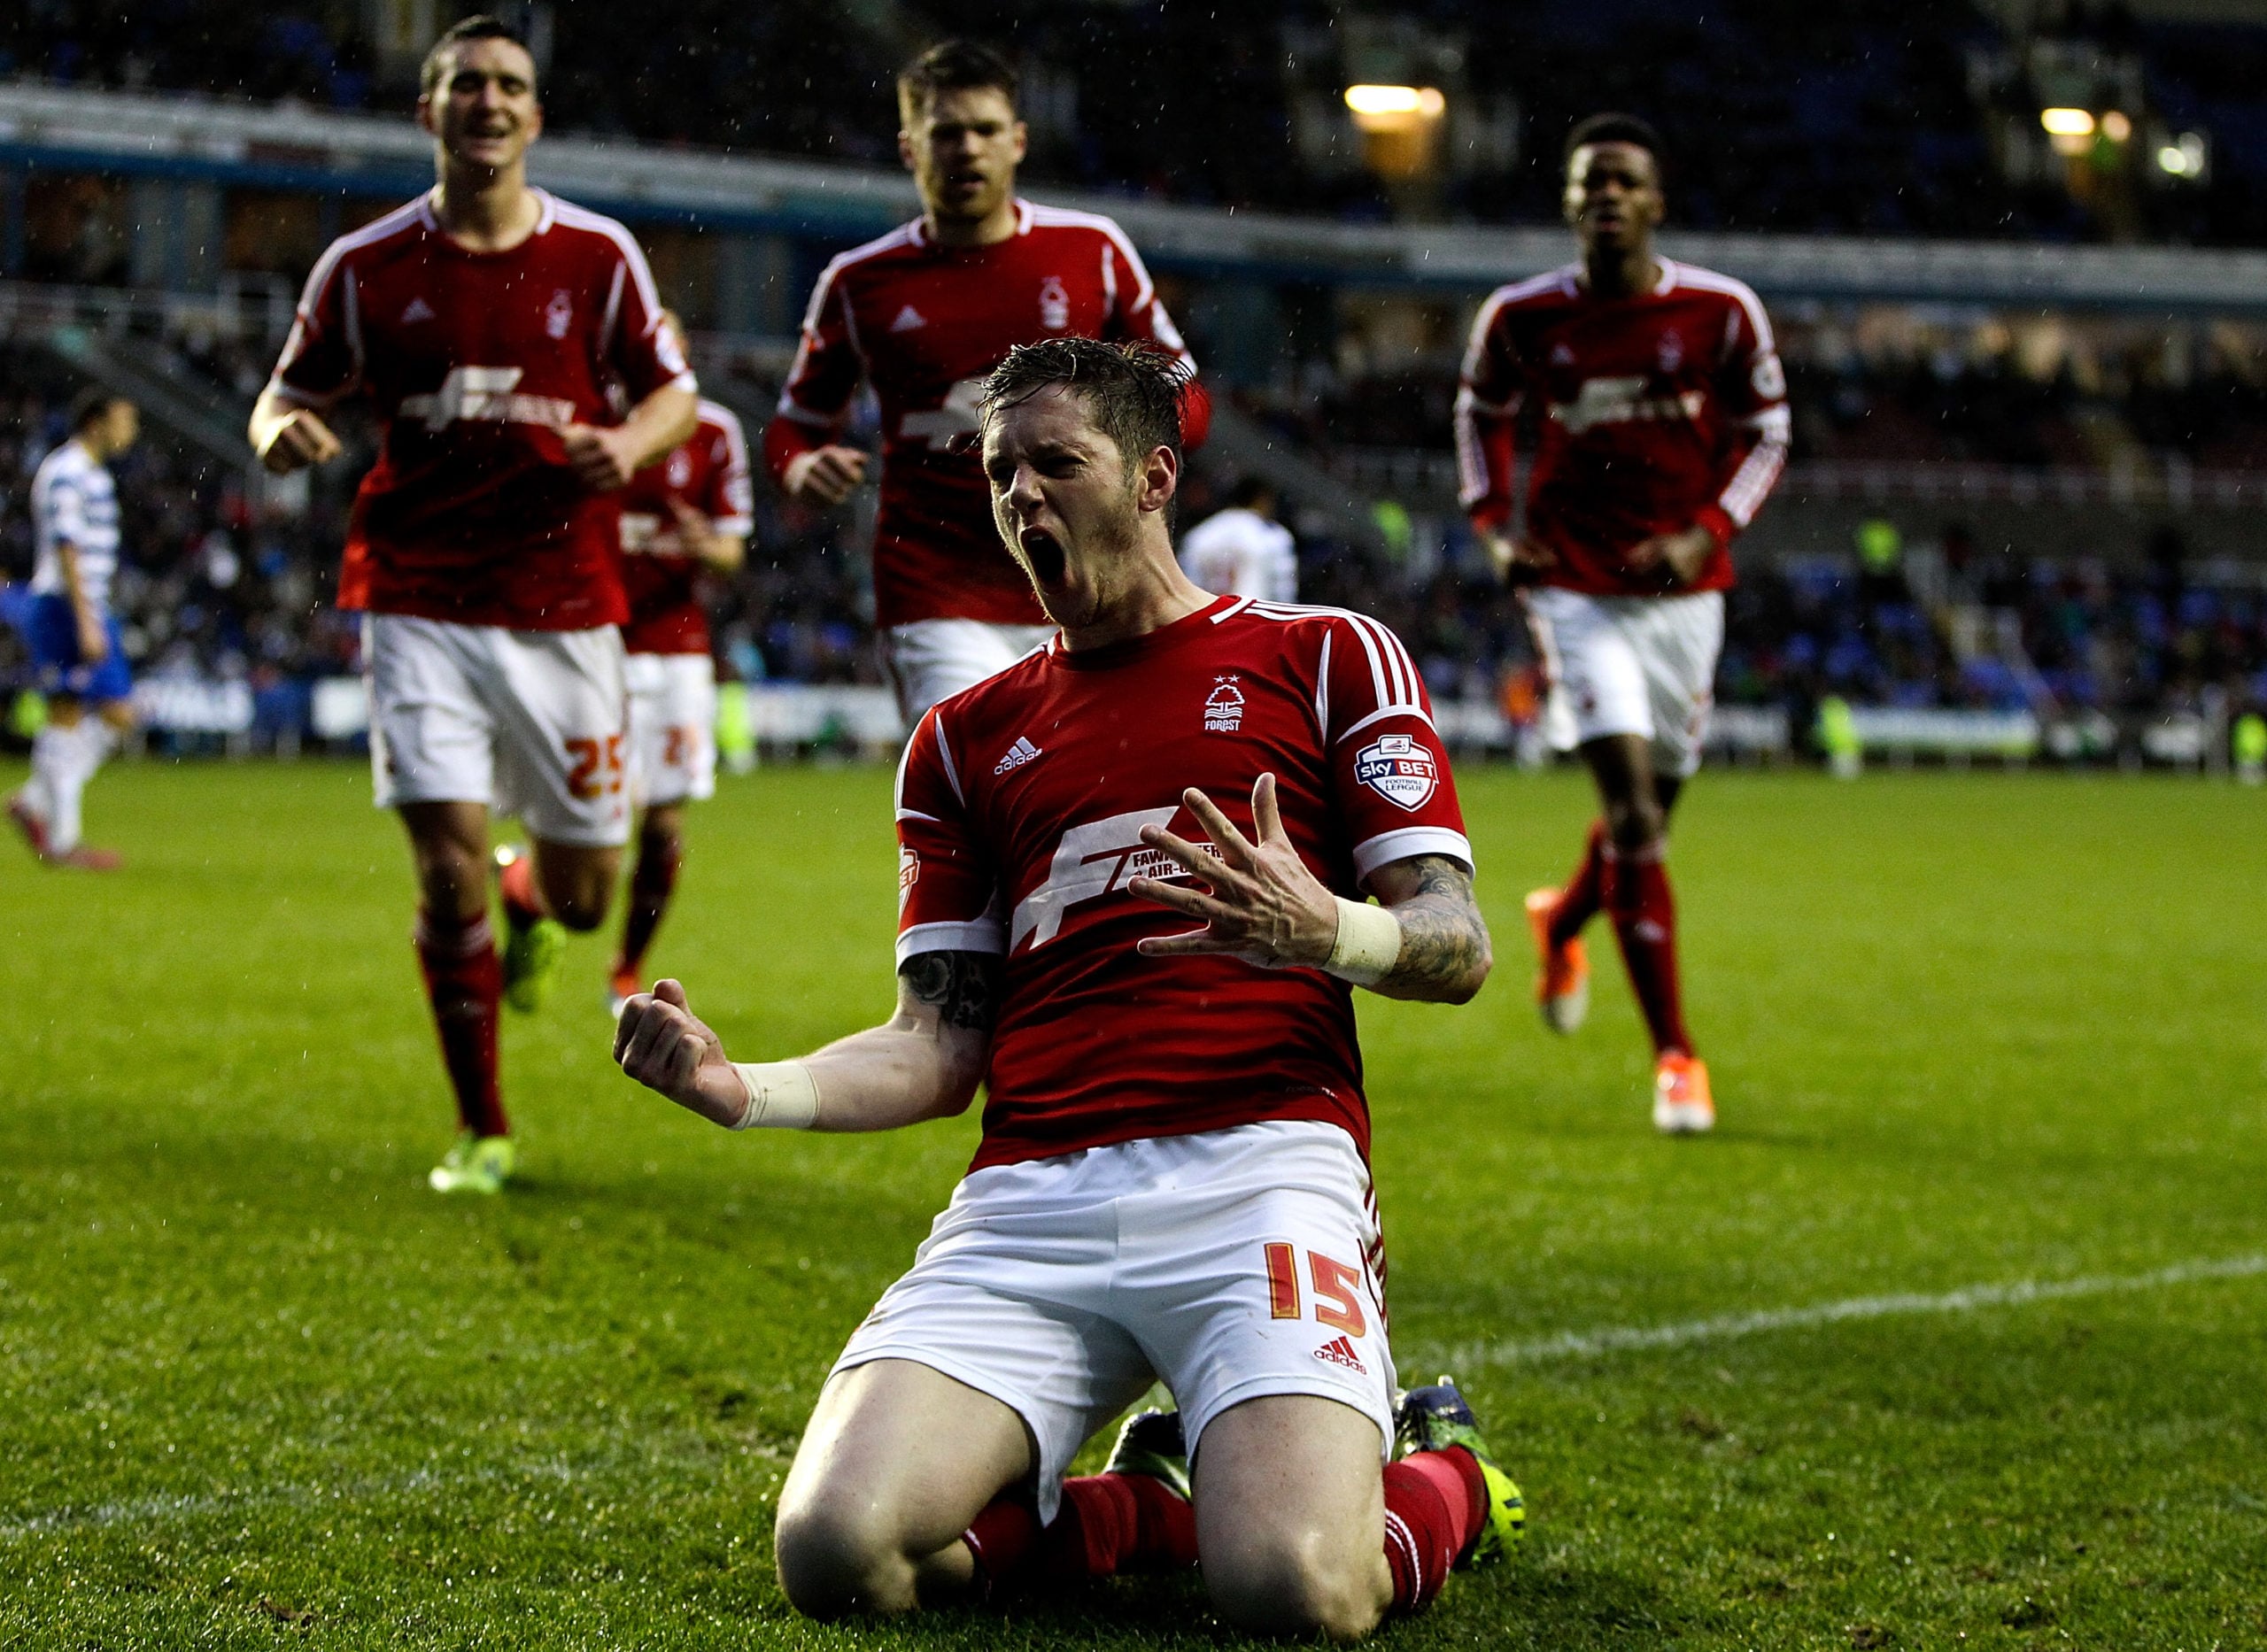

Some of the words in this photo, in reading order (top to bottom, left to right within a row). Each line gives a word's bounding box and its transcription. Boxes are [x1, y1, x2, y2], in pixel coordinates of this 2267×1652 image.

[994, 748, 1042, 776] adidas
[1398, 761, 1434, 777] BET
[1264, 1241, 1366, 1339] 15
[1313, 1349, 1367, 1375] adidas
